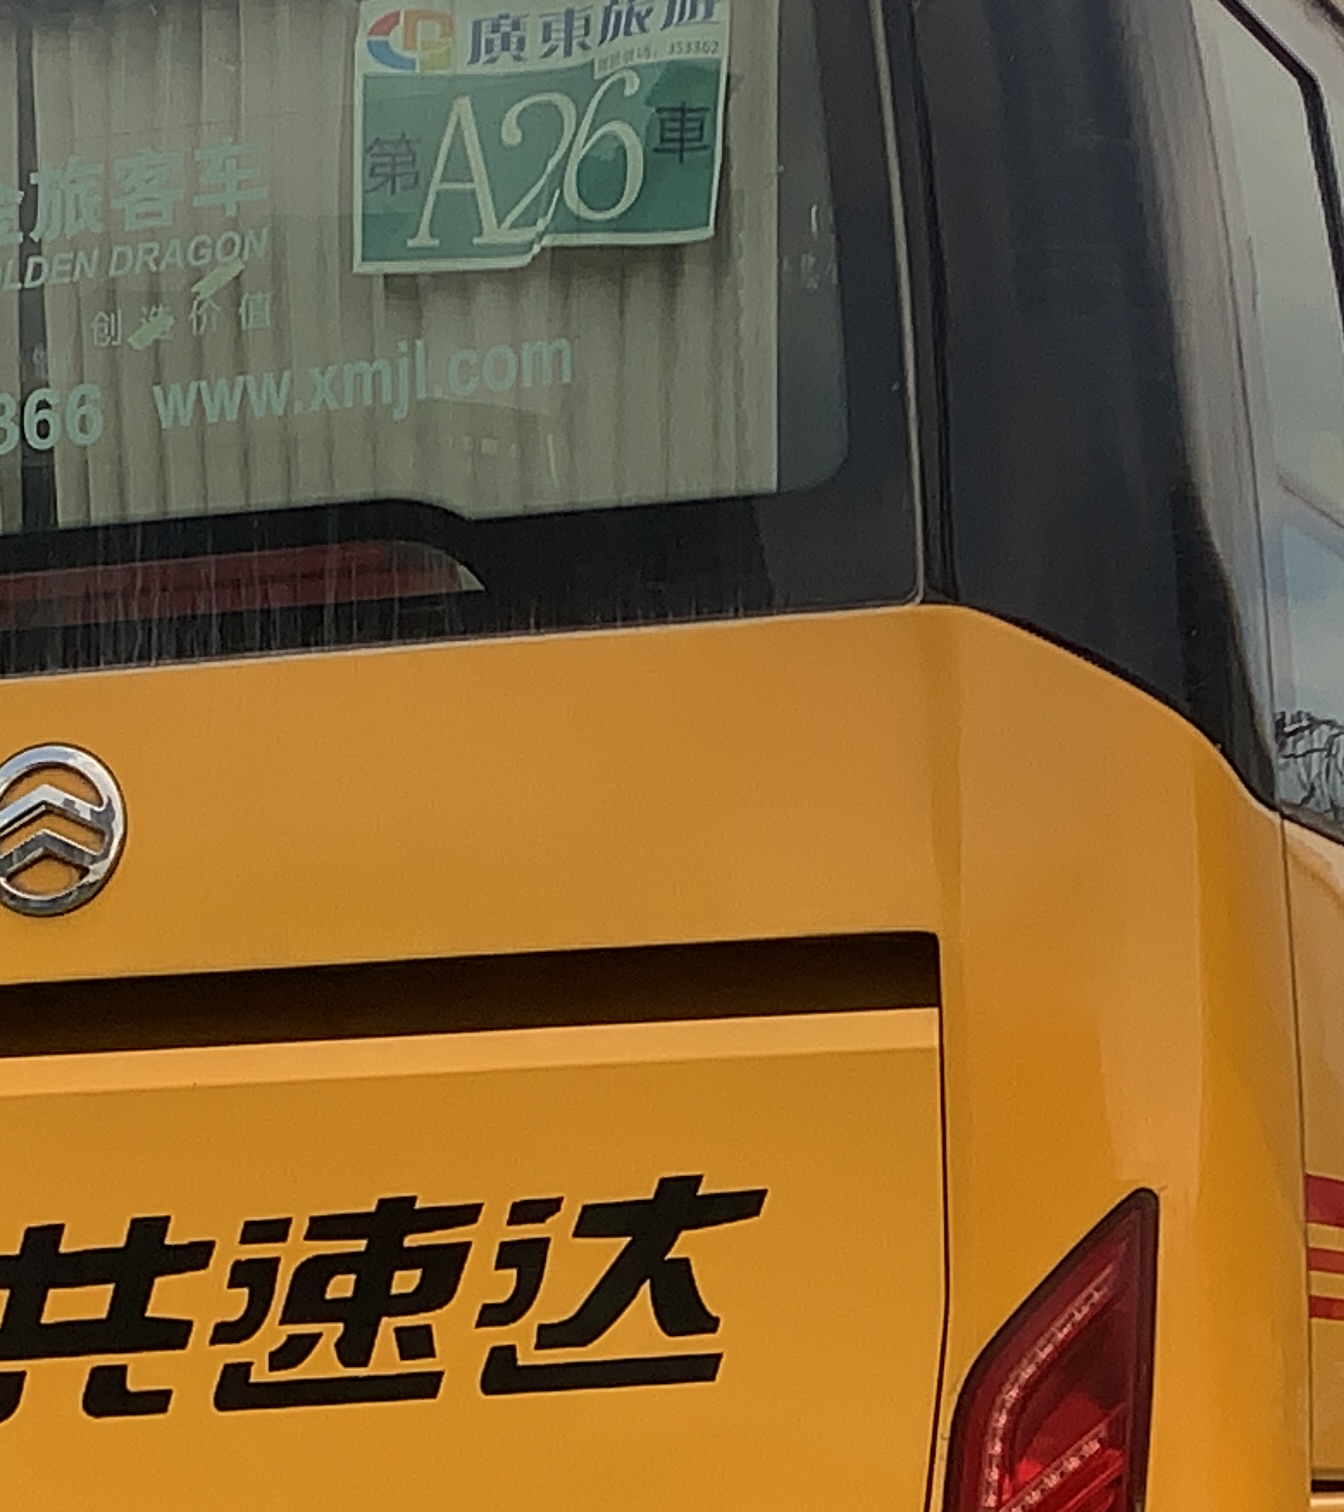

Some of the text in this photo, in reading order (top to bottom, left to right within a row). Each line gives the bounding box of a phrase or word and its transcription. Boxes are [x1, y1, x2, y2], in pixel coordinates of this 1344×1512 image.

[363, 68, 712, 248] 第 A26 車
[108, 227, 271, 280] DRAGON
[153, 332, 573, 429] www.xmjl.com
